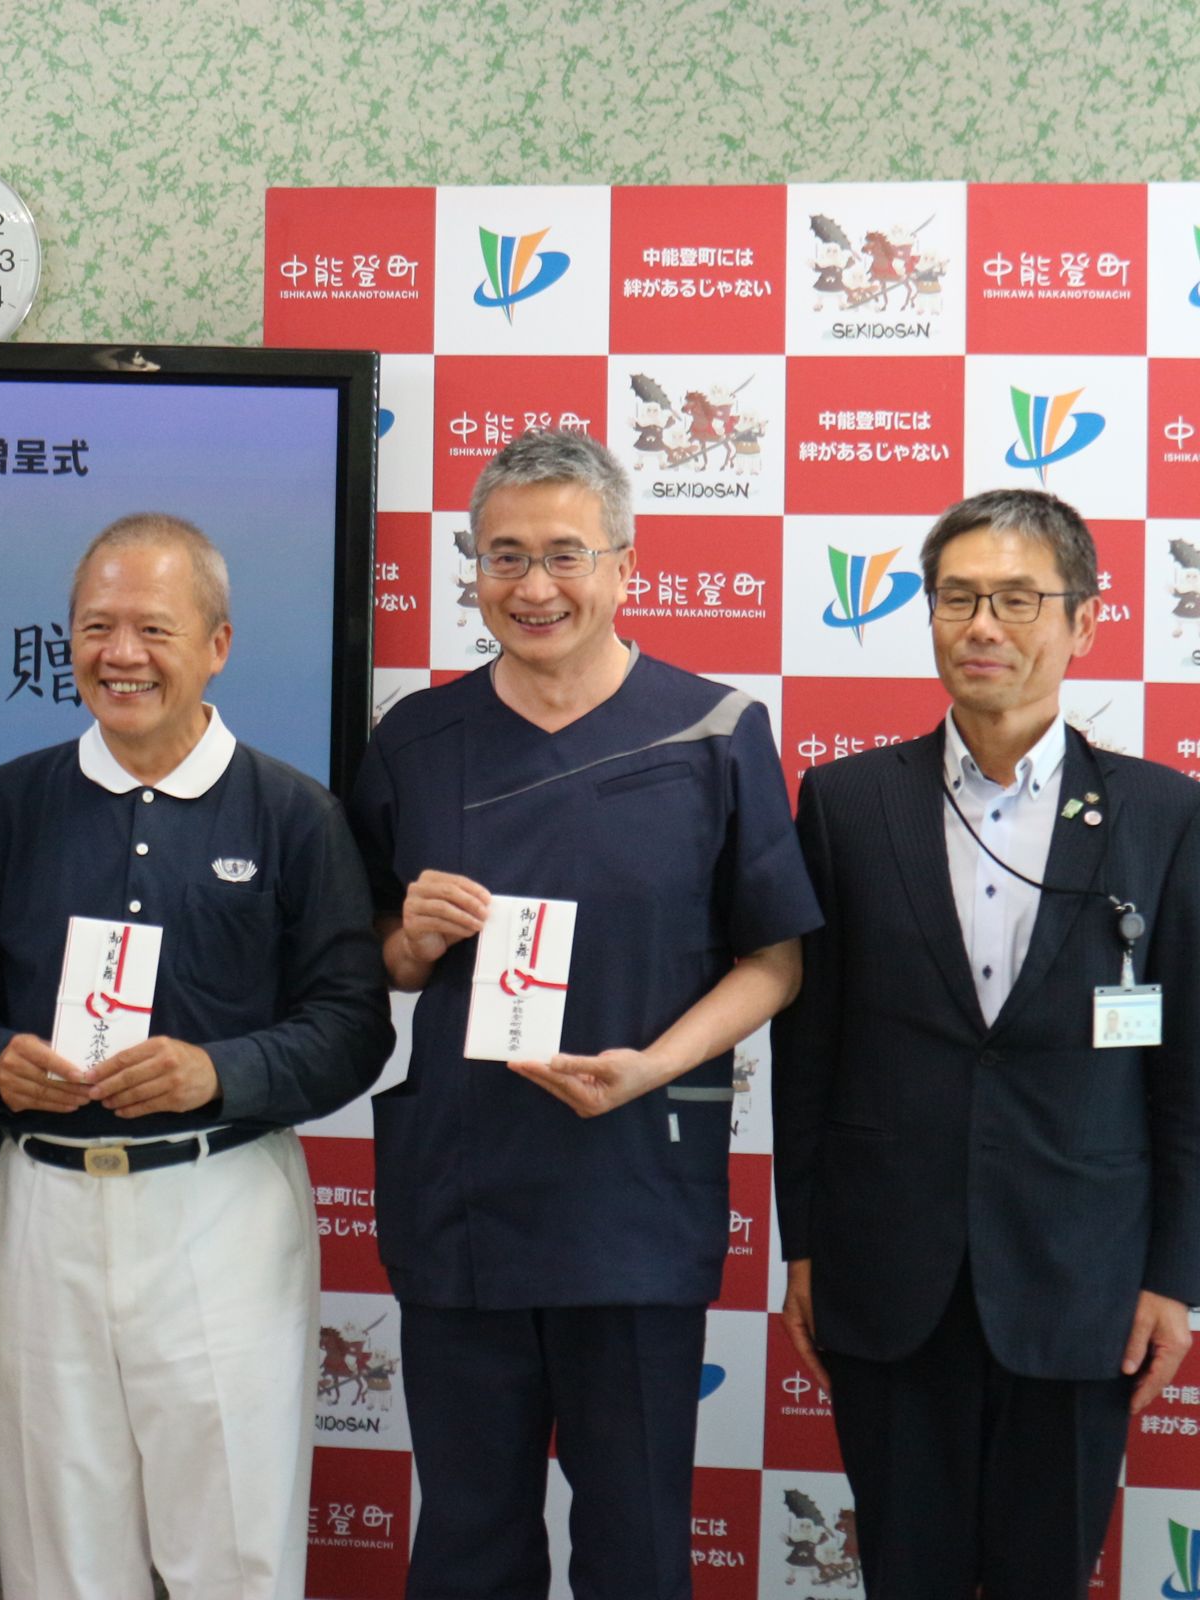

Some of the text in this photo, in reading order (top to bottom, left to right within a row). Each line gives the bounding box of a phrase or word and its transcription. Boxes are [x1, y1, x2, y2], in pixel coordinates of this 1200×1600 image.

[643, 247, 754, 267] 中能登町には
[280, 254, 419, 287] 中能登町
[983, 252, 1131, 287] 中能登町
[280, 290, 419, 299] ISHIKAWA NAKANOTOMACHI
[623, 278, 772, 298] 絆があるじゃない
[983, 288, 1131, 299] ISHIKAWA NAKANOTOMACHI
[818, 410, 931, 430] 中能登町には
[450, 447, 498, 457] ISHIKAWA
[799, 441, 950, 462] 絆があるじゃない
[1164, 453, 1200, 462] ISHIKA
[627, 571, 765, 606] 中能登町
[622, 608, 766, 618] ISHIKAWA NAKANOTOMACHI
[782, 1407, 832, 1416] ISHIKAWA
